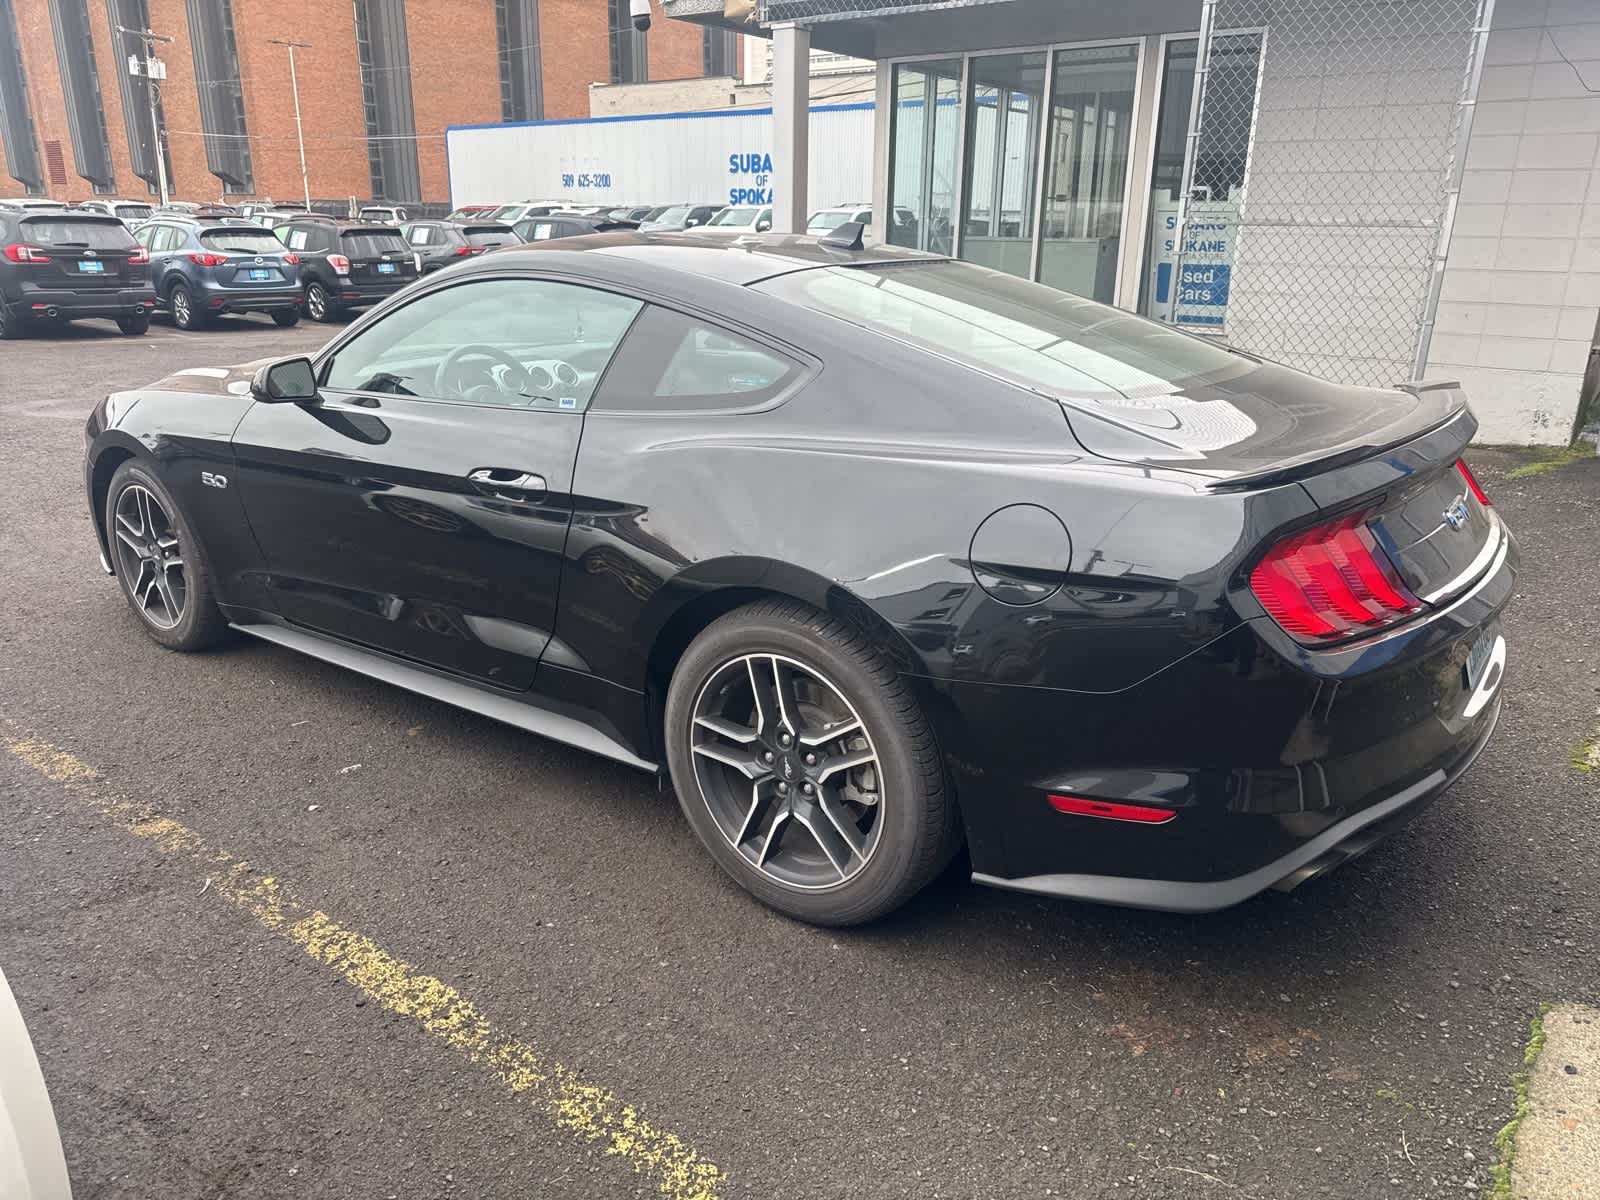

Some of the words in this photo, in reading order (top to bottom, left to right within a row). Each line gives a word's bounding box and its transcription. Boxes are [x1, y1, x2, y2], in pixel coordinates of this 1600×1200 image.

[562, 173, 574, 188] 509
[578, 173, 611, 188] 625-3200
[755, 174, 768, 187] OF
[1165, 240, 1226, 252] SKANE
[1183, 268, 1214, 284] sed
